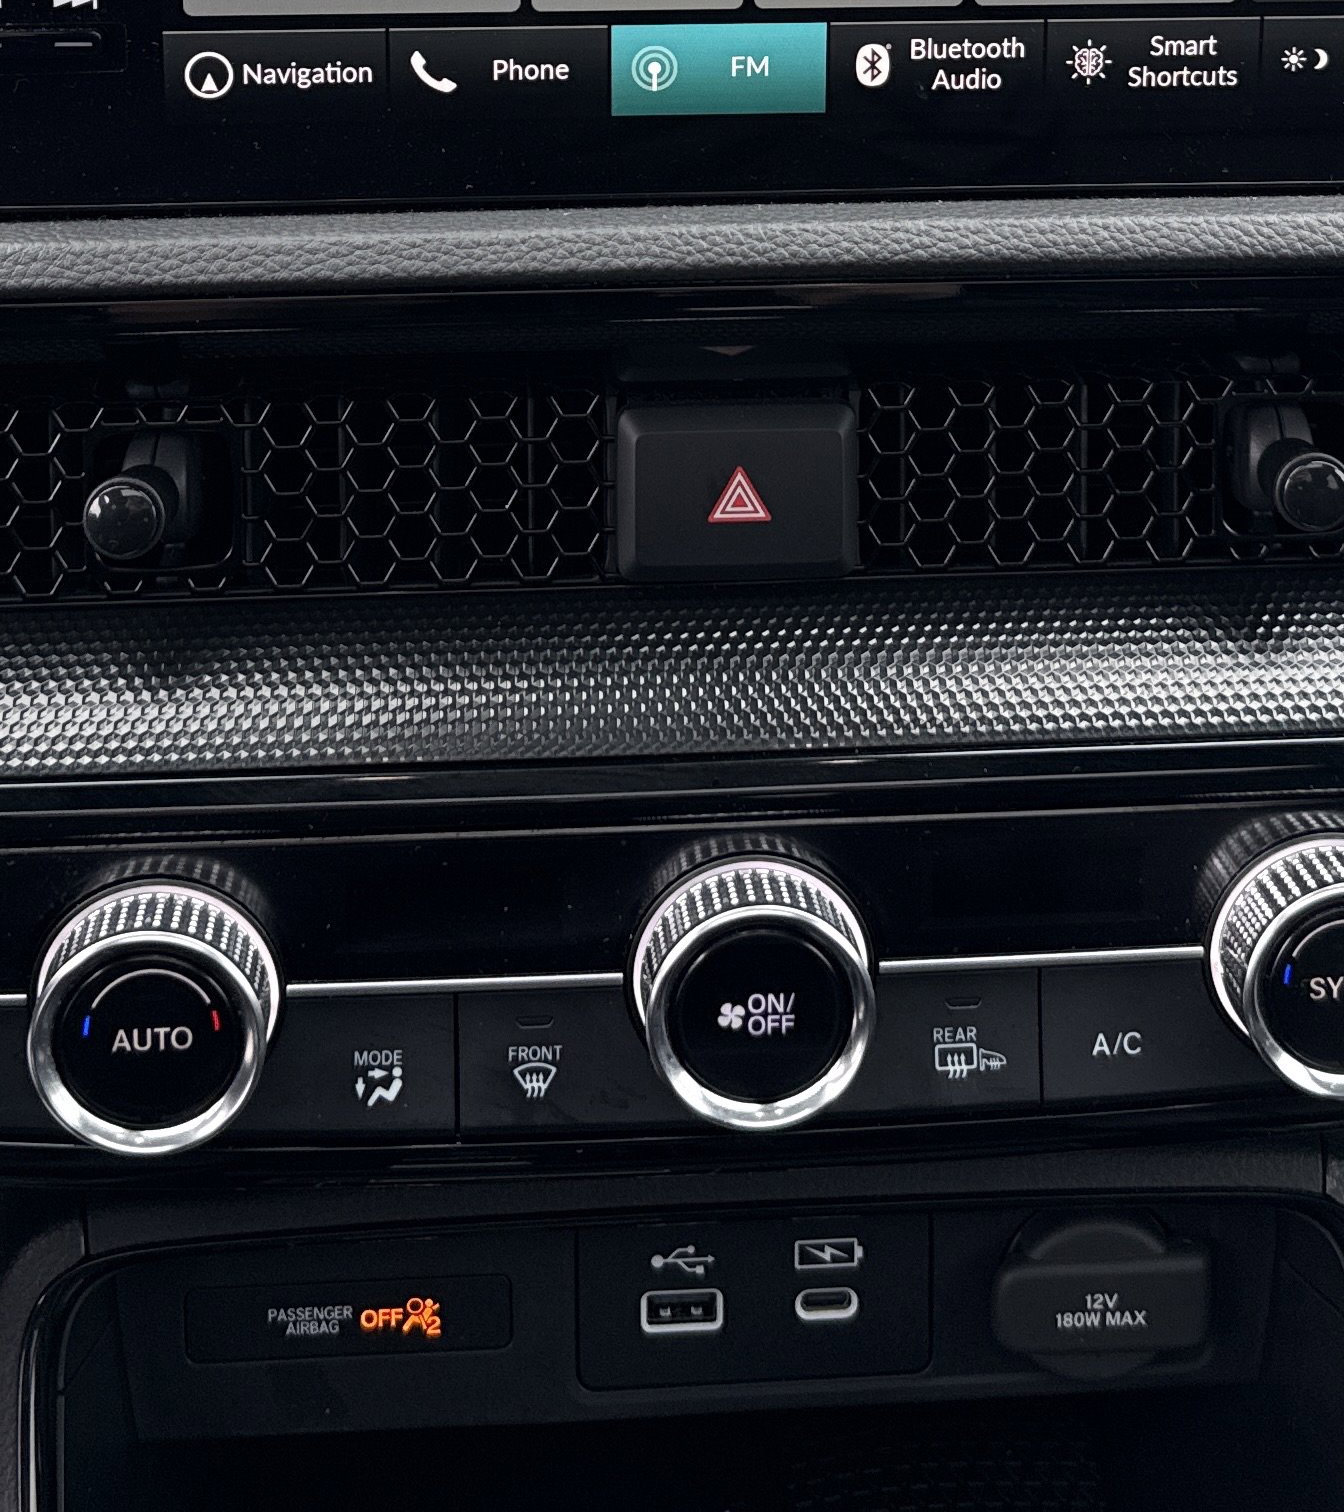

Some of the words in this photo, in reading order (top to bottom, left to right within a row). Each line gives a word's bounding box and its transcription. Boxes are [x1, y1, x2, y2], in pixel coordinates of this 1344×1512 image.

[909, 35, 1027, 62] Bluetooth
[1148, 34, 1219, 58] Smart
[242, 57, 374, 90] Navigation
[491, 55, 571, 84] Phone
[729, 55, 771, 79] FM
[1127, 63, 1239, 89] Shortcuts
[931, 67, 1003, 92] Audio
[747, 990, 797, 1015] ON/
[747, 1013, 796, 1037] OFF
[931, 1026, 978, 1043] REAR
[110, 1025, 194, 1055] AUTO
[1091, 1030, 1144, 1058] A/C
[352, 1049, 404, 1067] MODE
[506, 1045, 564, 1063] FRONT
[1085, 1292, 1119, 1310] 12V
[267, 1305, 353, 1322] PASSENGER
[359, 1308, 404, 1331] OFF
[1055, 1311, 1101, 1329] 180W
[1104, 1309, 1147, 1327] MAX
[285, 1320, 340, 1337] AIRBAG
